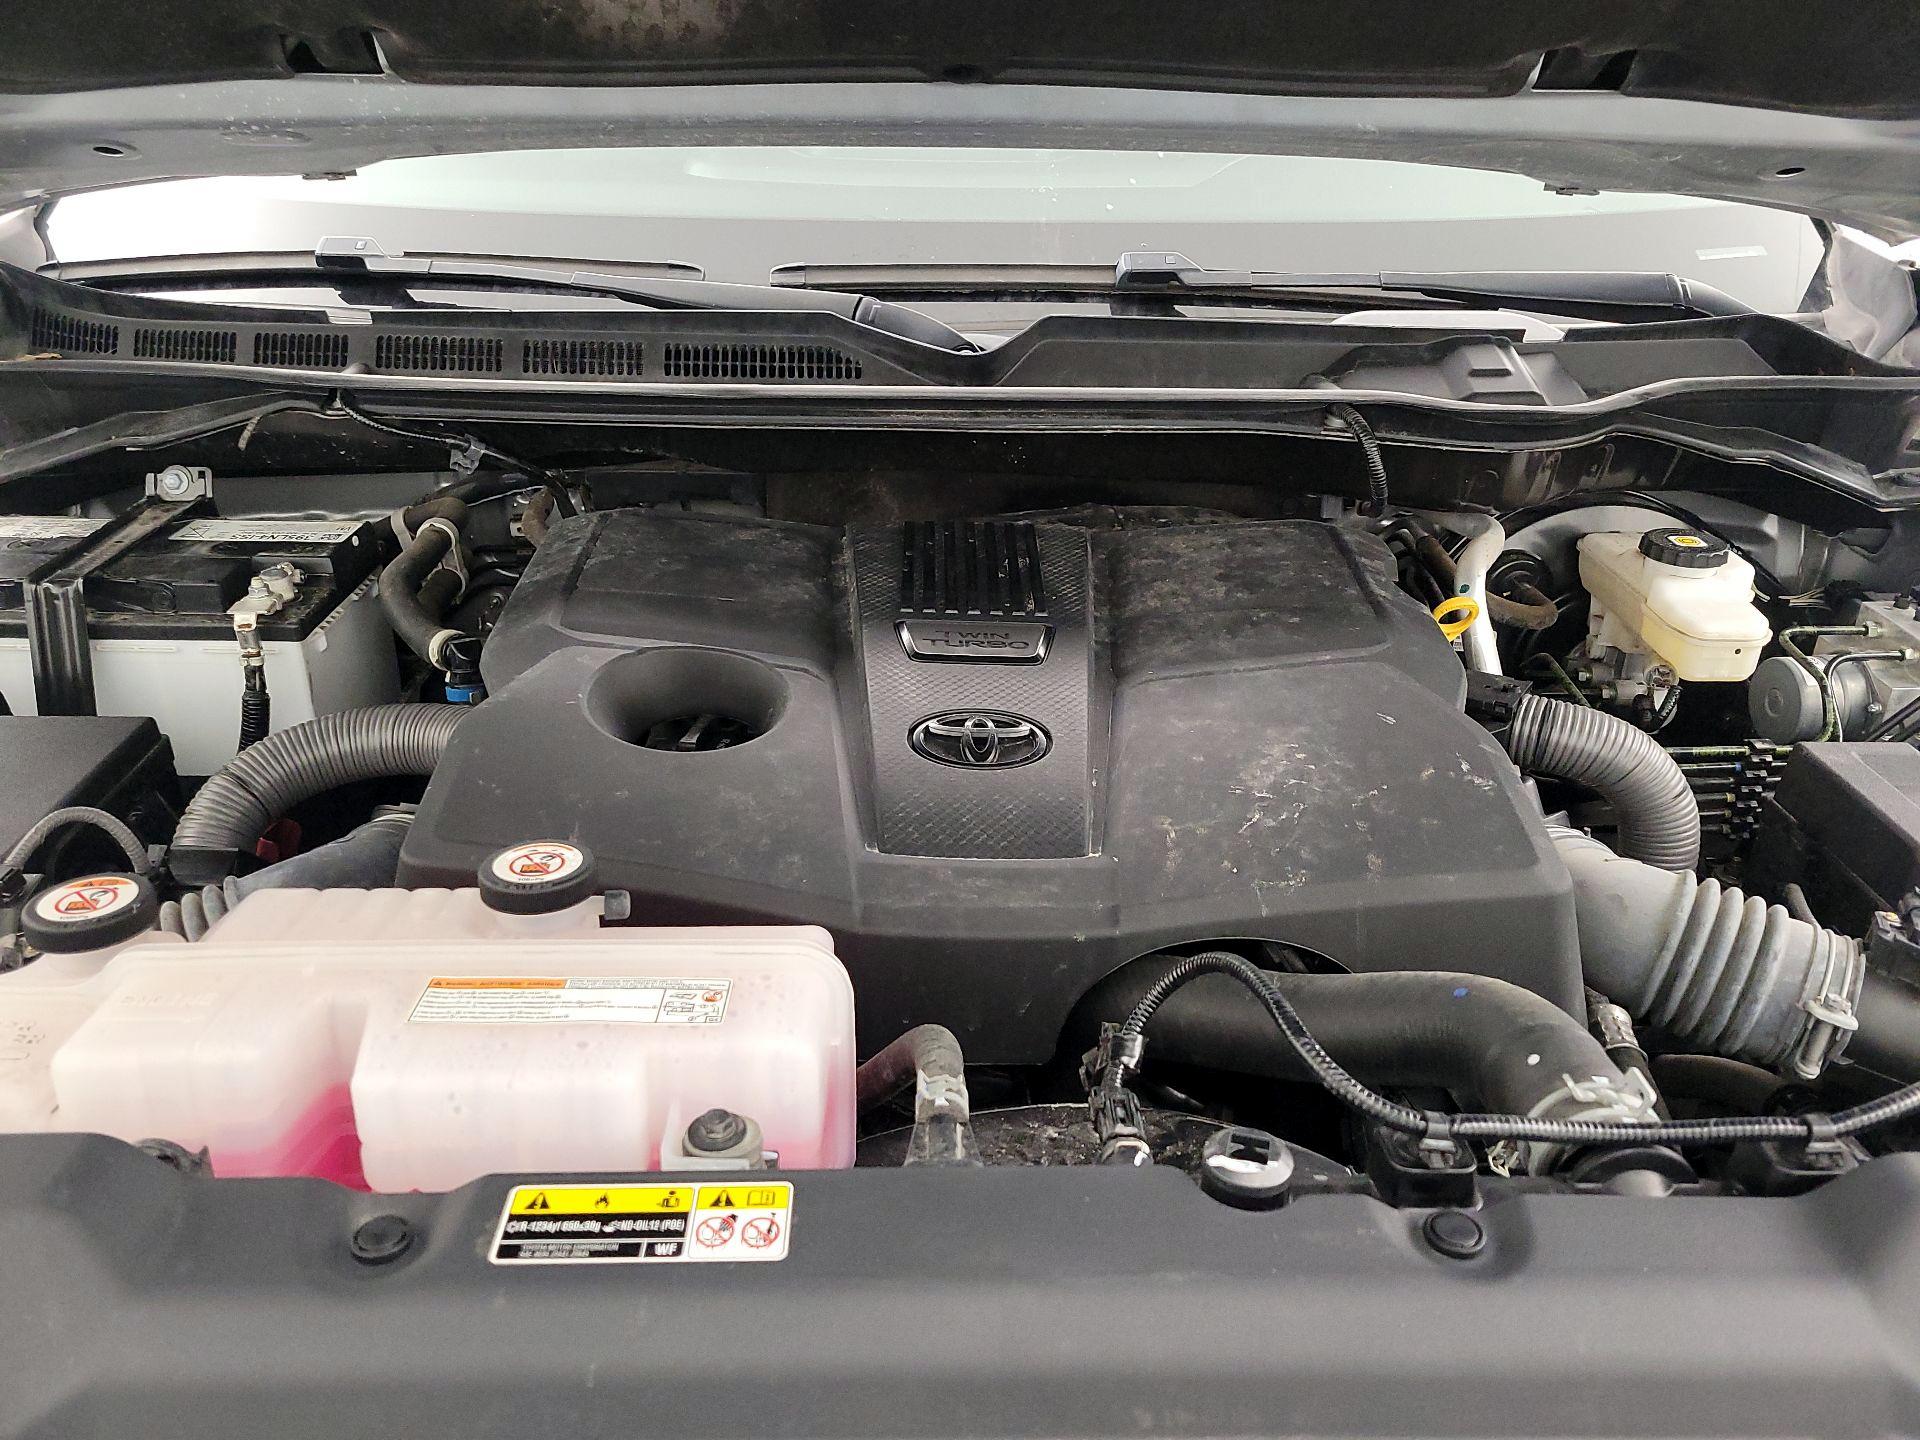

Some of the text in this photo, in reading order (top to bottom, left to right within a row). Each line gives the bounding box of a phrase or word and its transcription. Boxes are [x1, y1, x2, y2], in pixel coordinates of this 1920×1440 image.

[934, 630, 1010, 640] TWIN
[922, 638, 1030, 650] TURBO
[653, 1242, 678, 1256] WF
